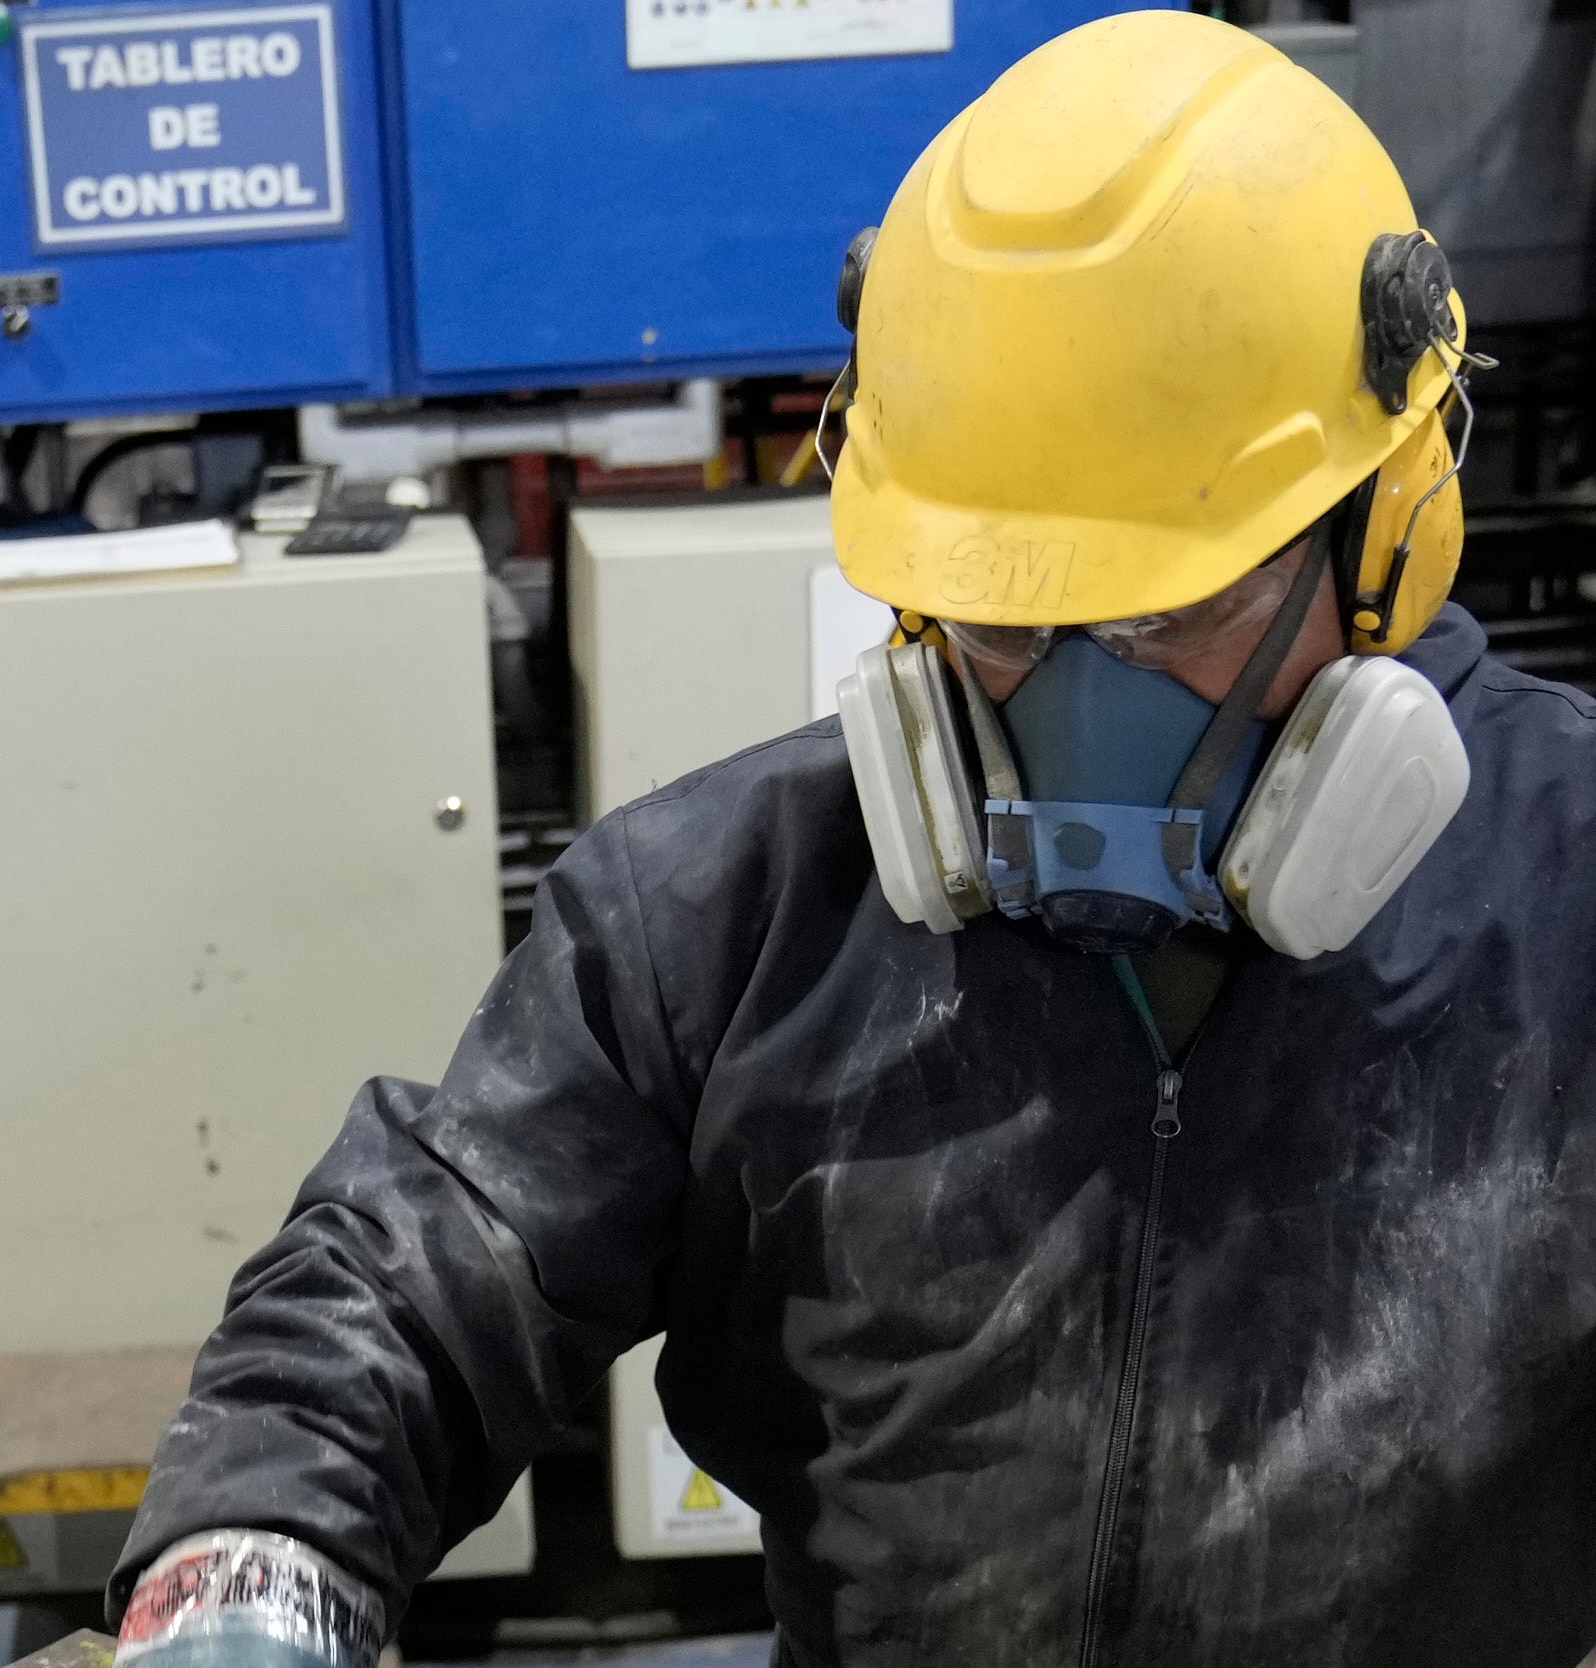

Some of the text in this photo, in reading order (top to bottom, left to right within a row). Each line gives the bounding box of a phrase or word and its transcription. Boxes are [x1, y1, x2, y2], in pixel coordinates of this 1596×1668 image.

[57, 32, 301, 91] TABLERO
[148, 103, 221, 150] DE
[63, 162, 316, 221] CONTROL
[939, 535, 1076, 609] 3M
